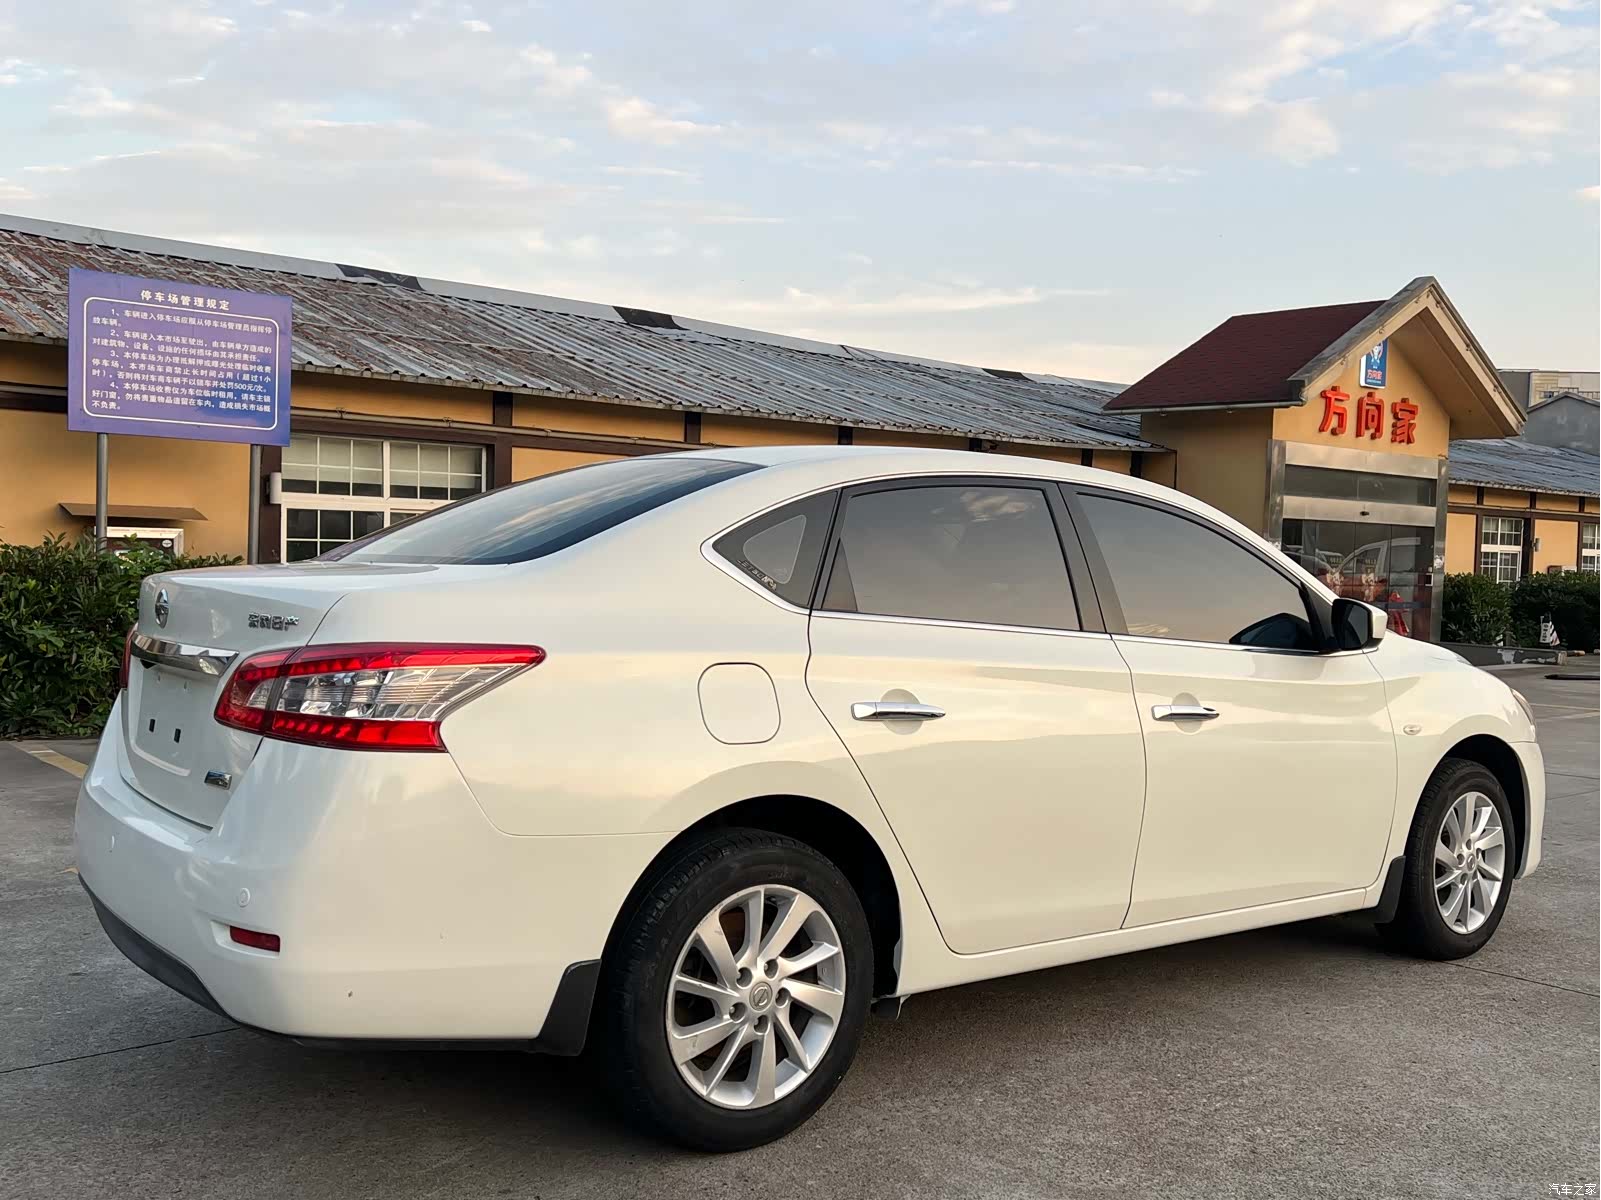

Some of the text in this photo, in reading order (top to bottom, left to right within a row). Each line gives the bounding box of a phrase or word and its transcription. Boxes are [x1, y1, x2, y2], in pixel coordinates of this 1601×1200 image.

[140, 290, 230, 311] 停车场管理规定
[1319, 386, 1418, 444] 方向家
